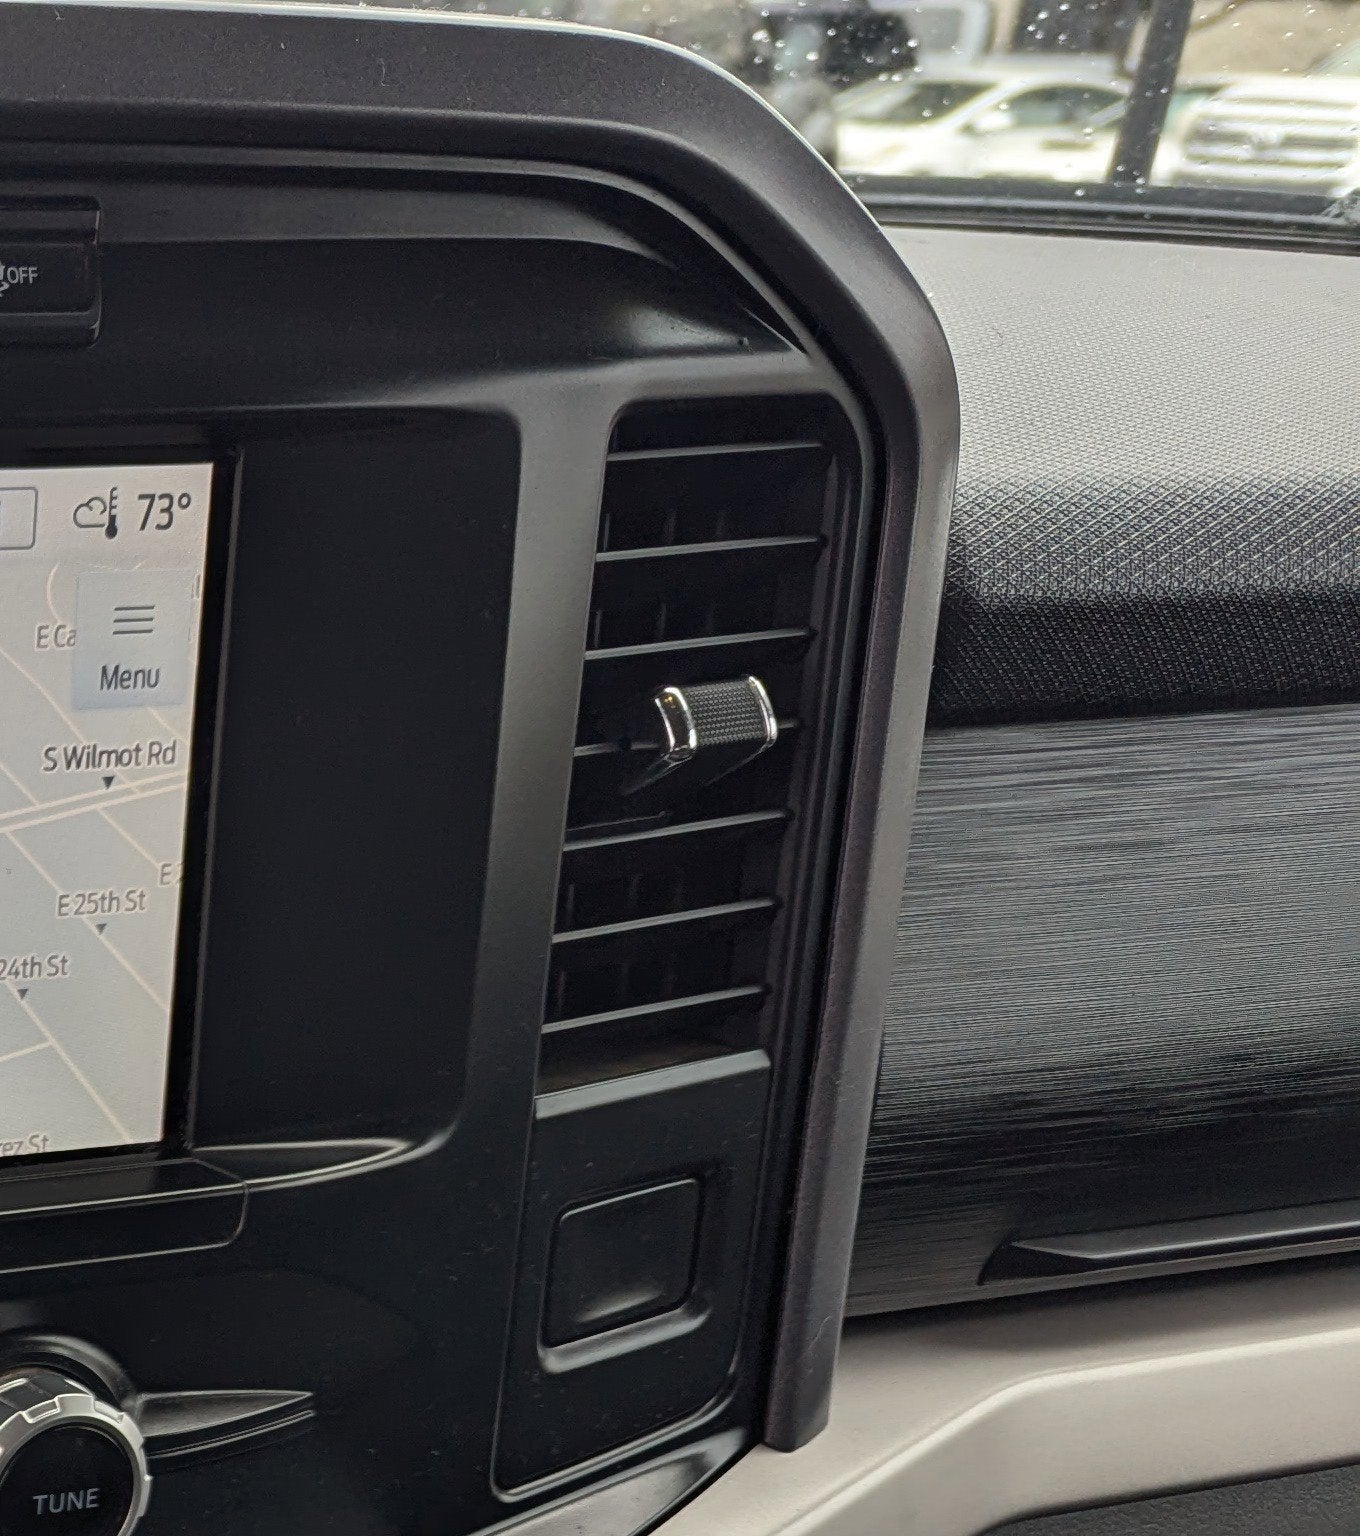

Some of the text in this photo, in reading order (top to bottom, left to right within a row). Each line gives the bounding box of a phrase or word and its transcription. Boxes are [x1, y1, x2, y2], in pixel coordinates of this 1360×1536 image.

[7, 266, 39, 284] OFF
[138, 492, 192, 532] 73°
[36, 624, 50, 649] E
[100, 664, 160, 691] Menu
[42, 738, 176, 772] S Wilmot Rd
[160, 862, 173, 886] E
[57, 889, 147, 917] E 25th St
[47, 954, 69, 978] St
[32, 1485, 101, 1517] TUNE
